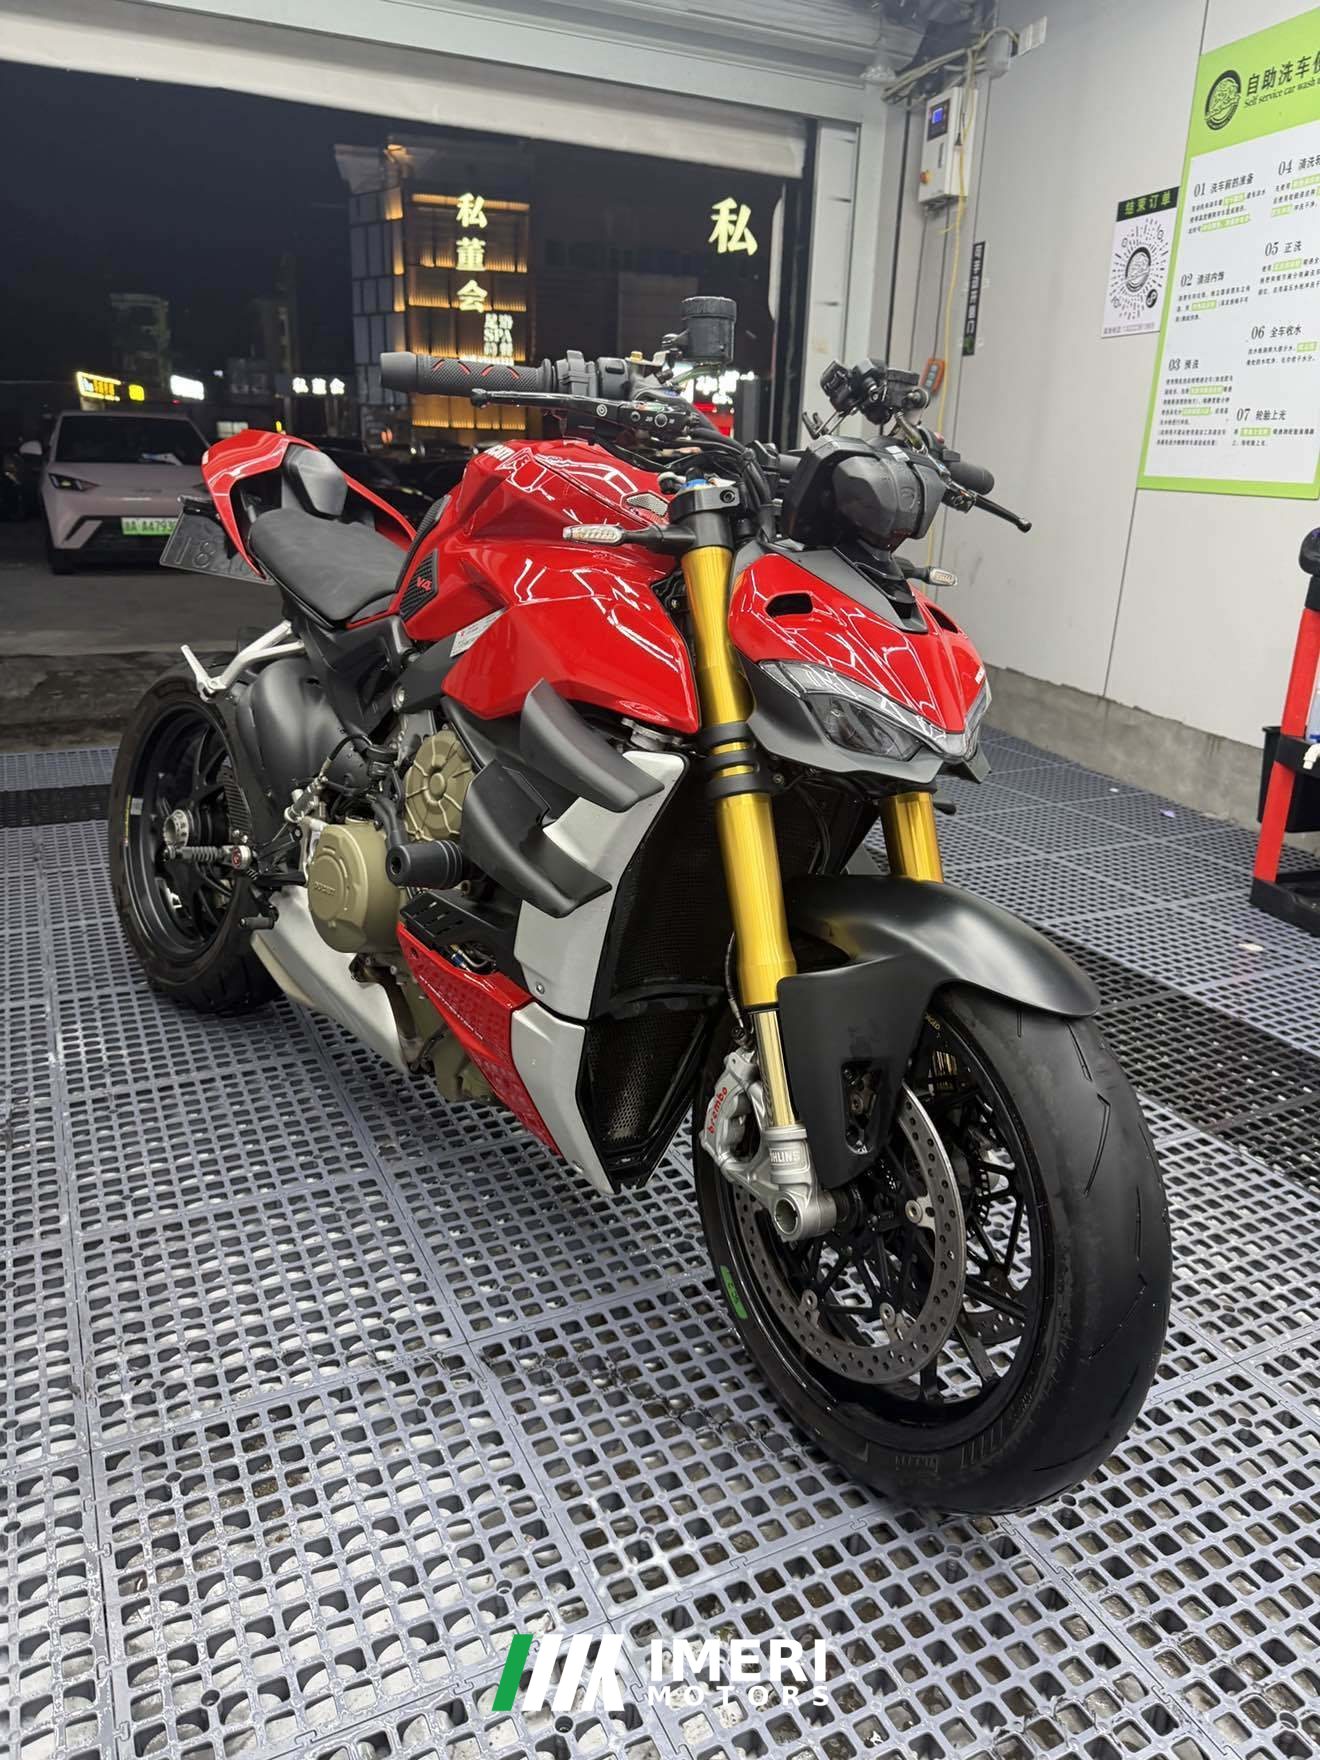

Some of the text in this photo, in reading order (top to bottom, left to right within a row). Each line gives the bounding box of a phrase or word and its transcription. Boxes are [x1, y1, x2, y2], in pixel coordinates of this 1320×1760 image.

[1278, 159, 1293, 176] 04
[1194, 182, 1206, 197] 01
[708, 197, 758, 256] 私
[456, 192, 488, 313] 私董会
[1264, 240, 1302, 256] 05 正洗
[1180, 273, 1193, 288] 02
[483, 328, 512, 343] SPA
[1251, 324, 1302, 339] 06 全车收水
[1168, 358, 1180, 372] 03
[1236, 408, 1251, 422] 07
[1256, 409, 1288, 421] 轮胎上光
[417, 576, 432, 591] V4
[706, 1086, 728, 1135] brembo
